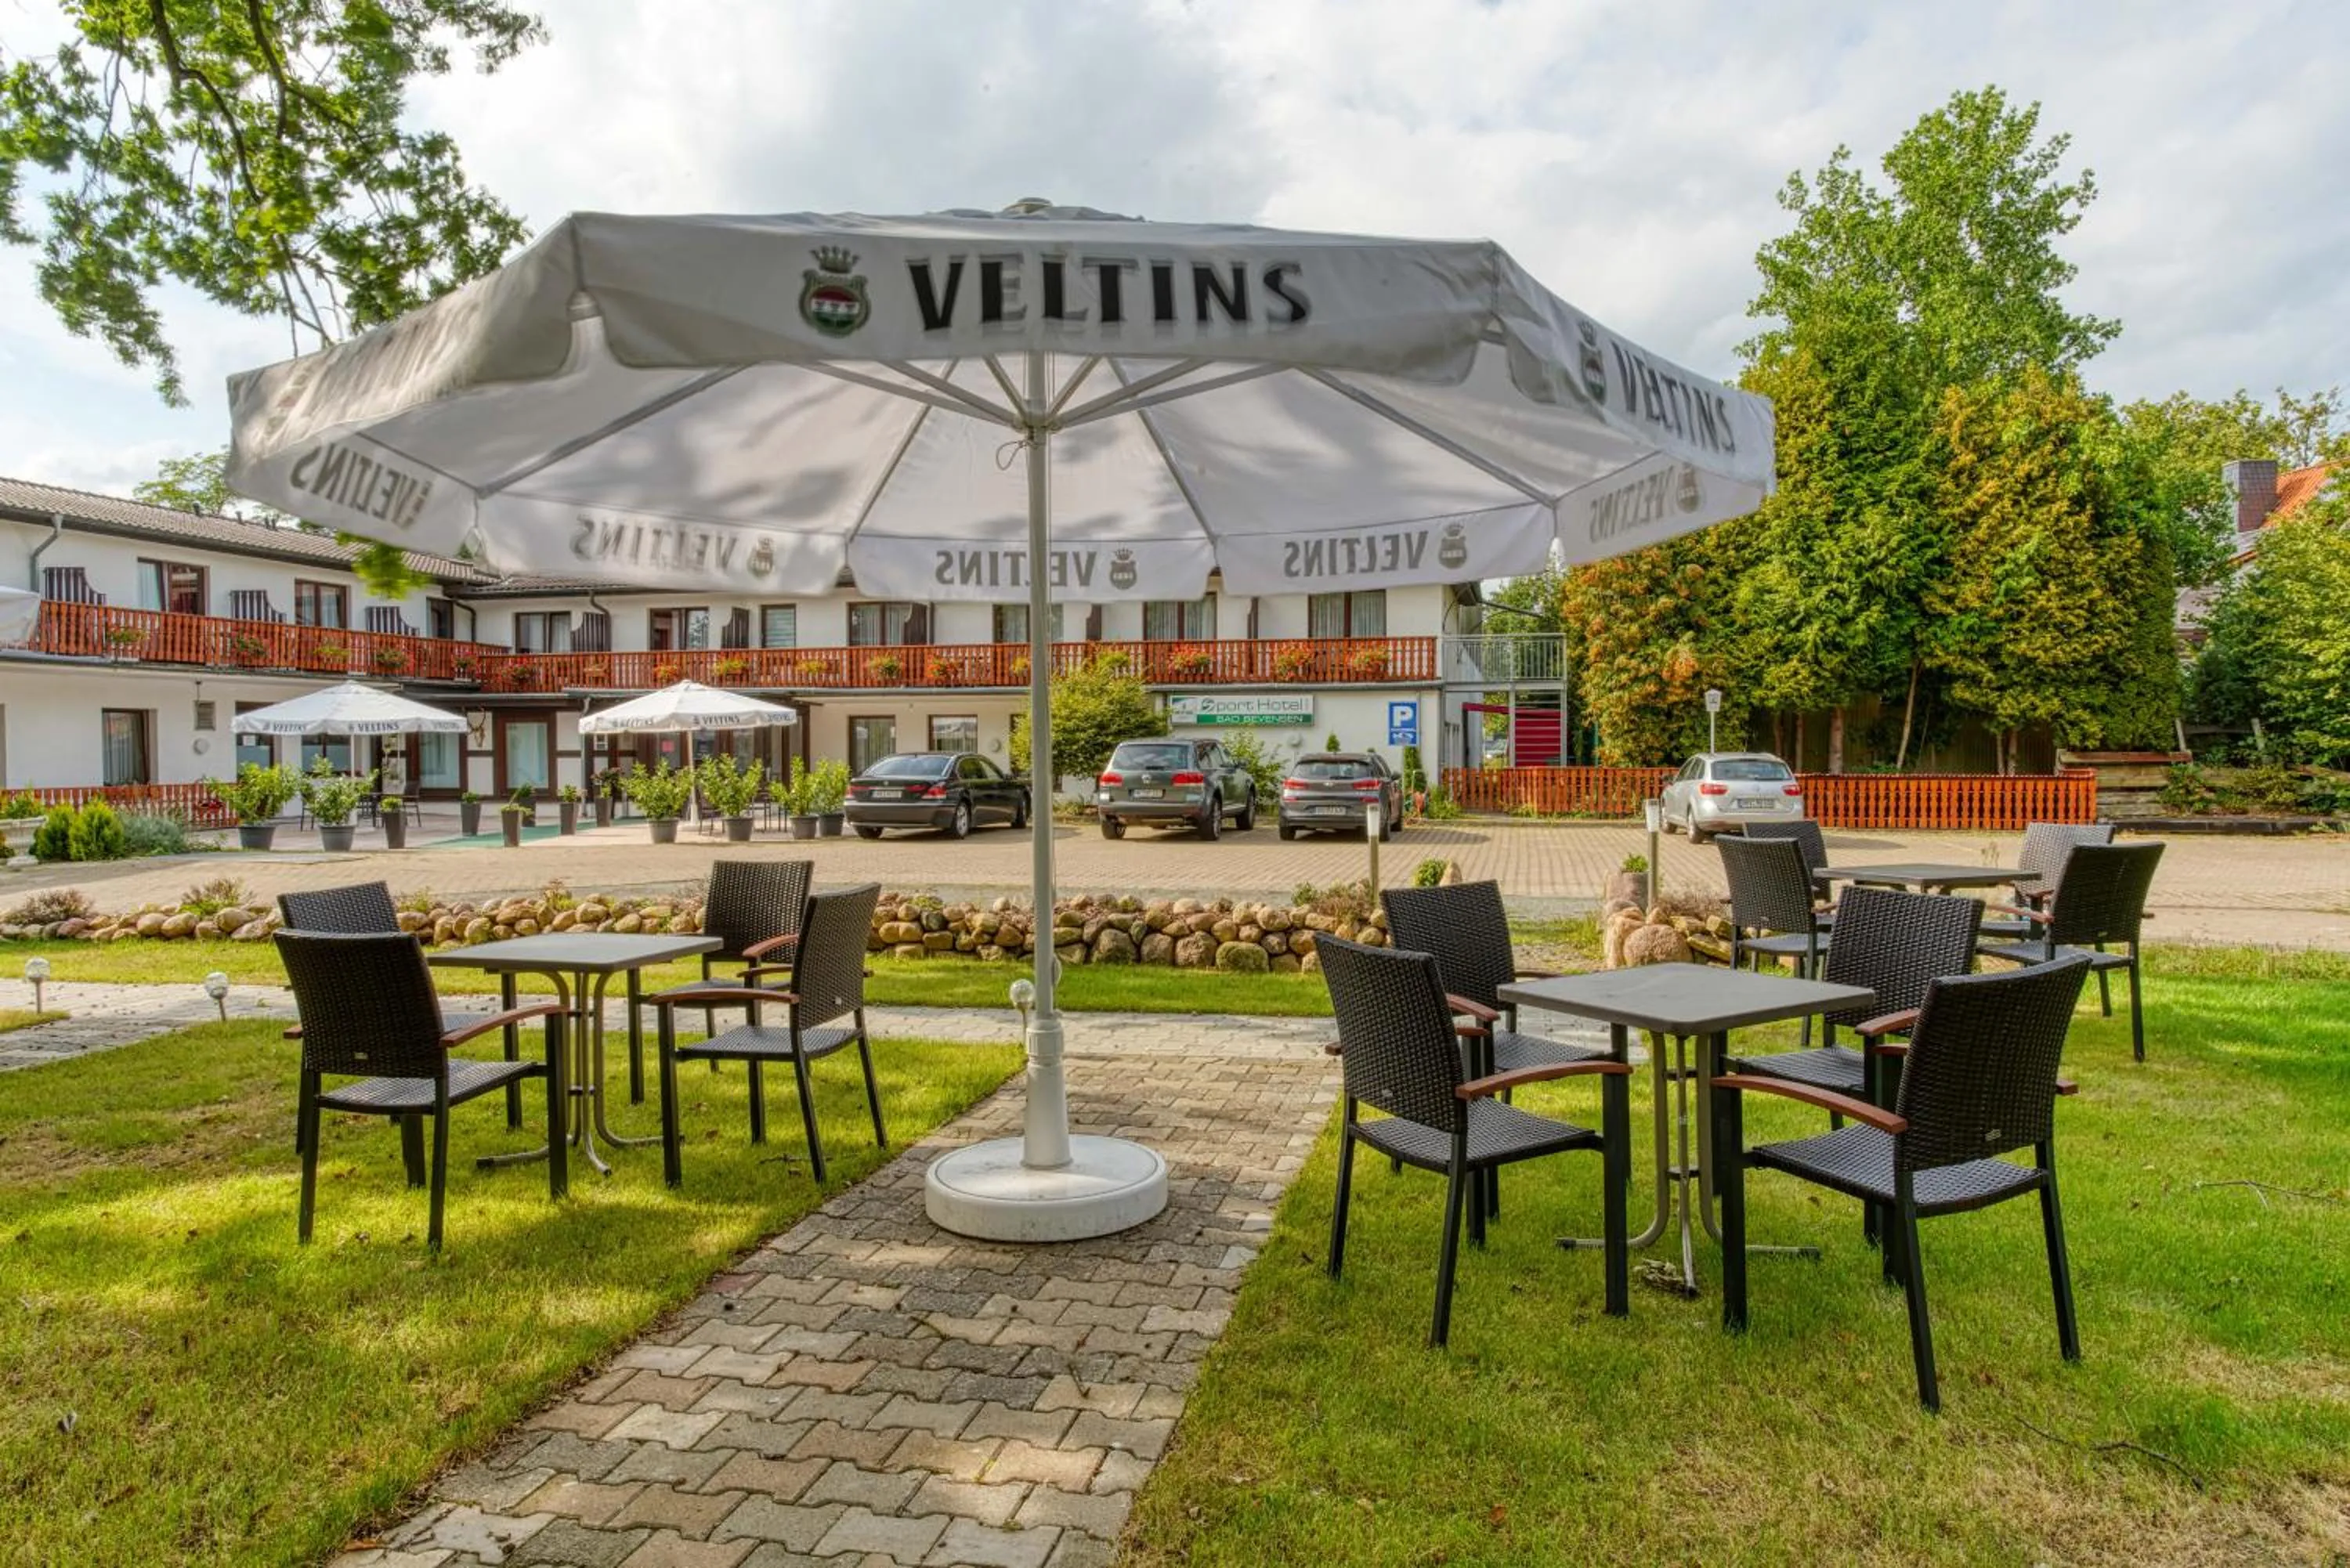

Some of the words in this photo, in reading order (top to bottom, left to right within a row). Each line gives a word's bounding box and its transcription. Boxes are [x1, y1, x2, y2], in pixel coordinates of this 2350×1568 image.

[905, 254, 1311, 331] VELTINS
[1610, 340, 1736, 457] VELTINS
[1257, 698, 1303, 711] Hotel
[1393, 706, 1414, 727] P
